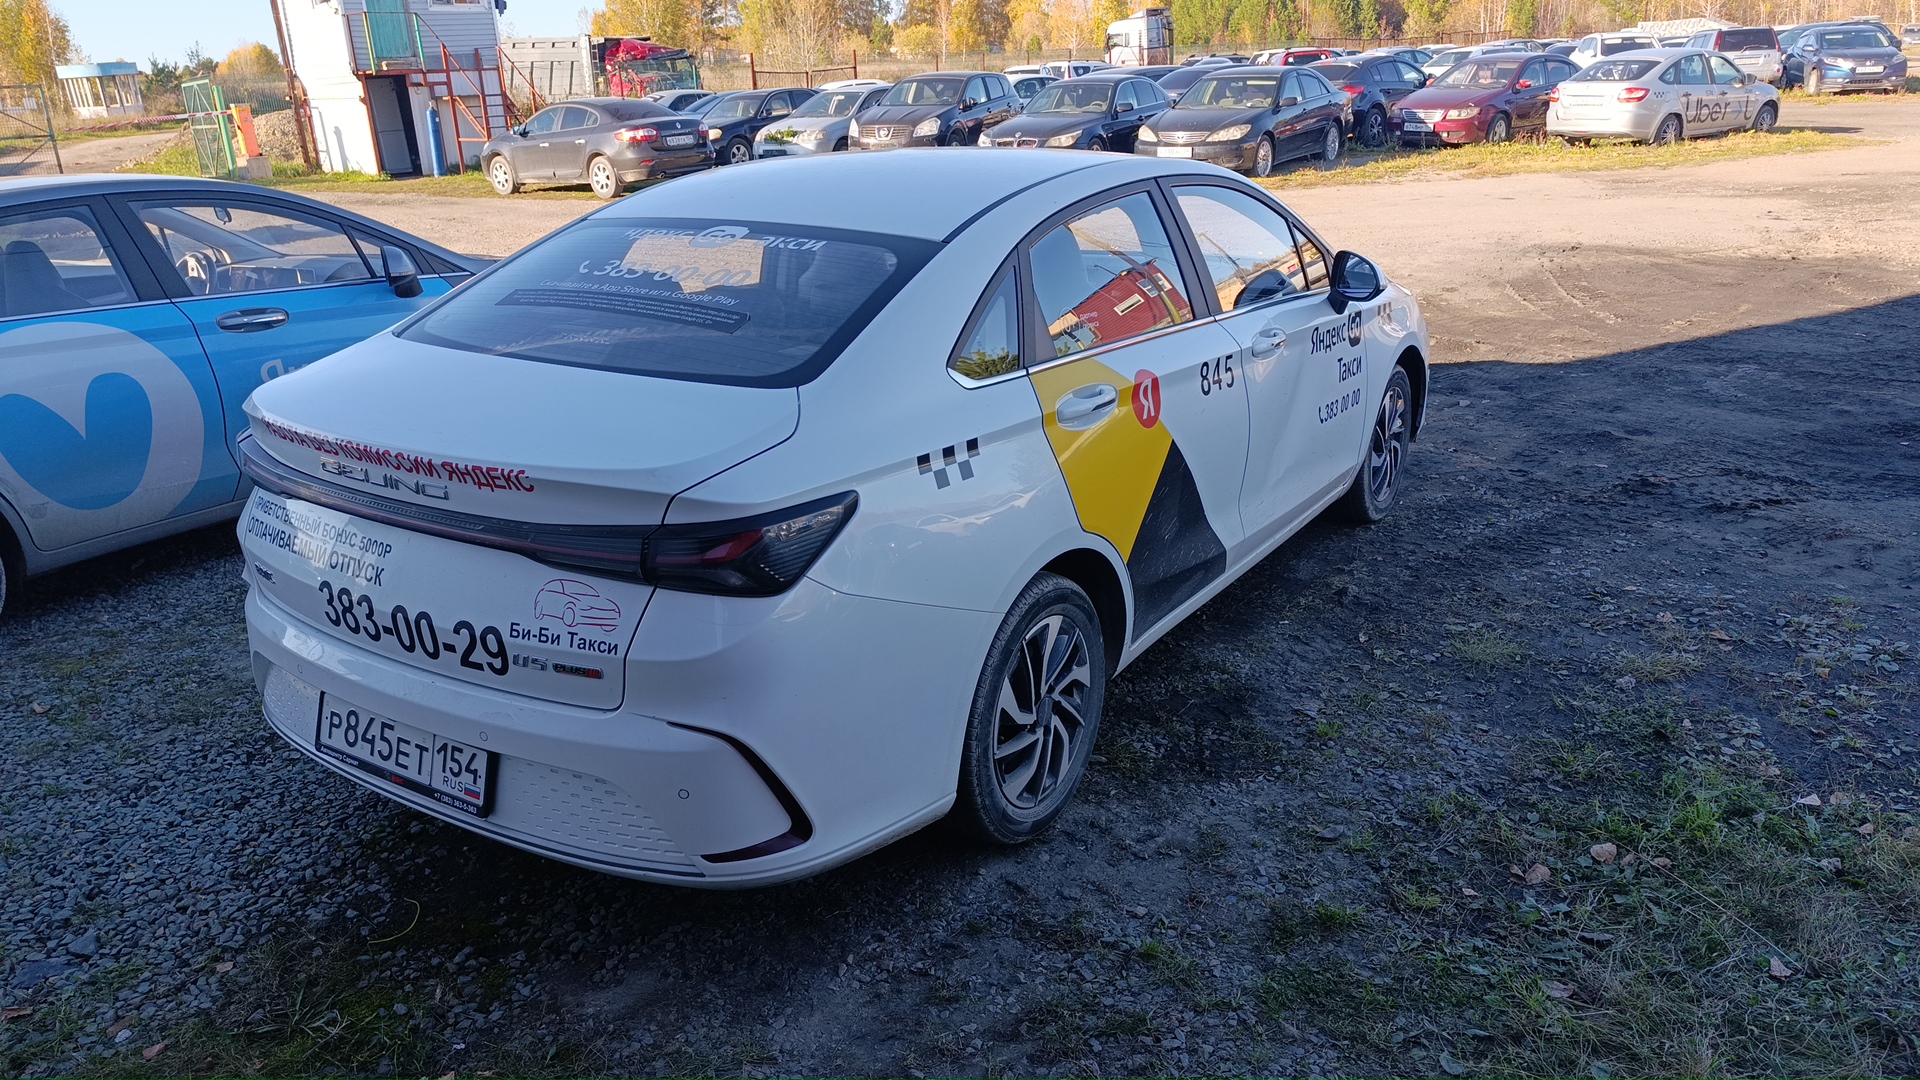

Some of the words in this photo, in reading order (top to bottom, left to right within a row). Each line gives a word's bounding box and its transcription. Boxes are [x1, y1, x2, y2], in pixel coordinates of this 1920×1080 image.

[1685, 97, 1731, 124] Uber
[592, 259, 752, 287] 383-00-00
[598, 283, 621, 293] App
[620, 285, 649, 295] Store
[671, 290, 713, 303] Google
[712, 295, 740, 307] Play
[1310, 322, 1346, 355] Яндекс
[1200, 353, 1235, 396] 845
[1337, 355, 1362, 384] Такси
[1324, 399, 1339, 422] 383
[1341, 393, 1350, 414] 00
[1351, 388, 1361, 408] 00
[320, 456, 450, 501] BEIJING
[333, 437, 442, 480] КОМИССИИ
[440, 460, 535, 493] ЯНДЕКС
[254, 495, 322, 538] ПРИВЕТСТВЕННЫЙ
[321, 522, 358, 548] БОНУС
[358, 535, 393, 559] 5000Р
[248, 516, 328, 565] ОПЛАЧИВАЕМЫЙ
[329, 550, 385, 587] ОТПУСК
[318, 580, 510, 677] 383-00-29
[509, 621, 561, 646] Би-Би
[567, 631, 619, 656] Такси
[327, 709, 429, 776] Р845ЕТ
[436, 741, 479, 786] 154
[442, 775, 464, 793] RUS
